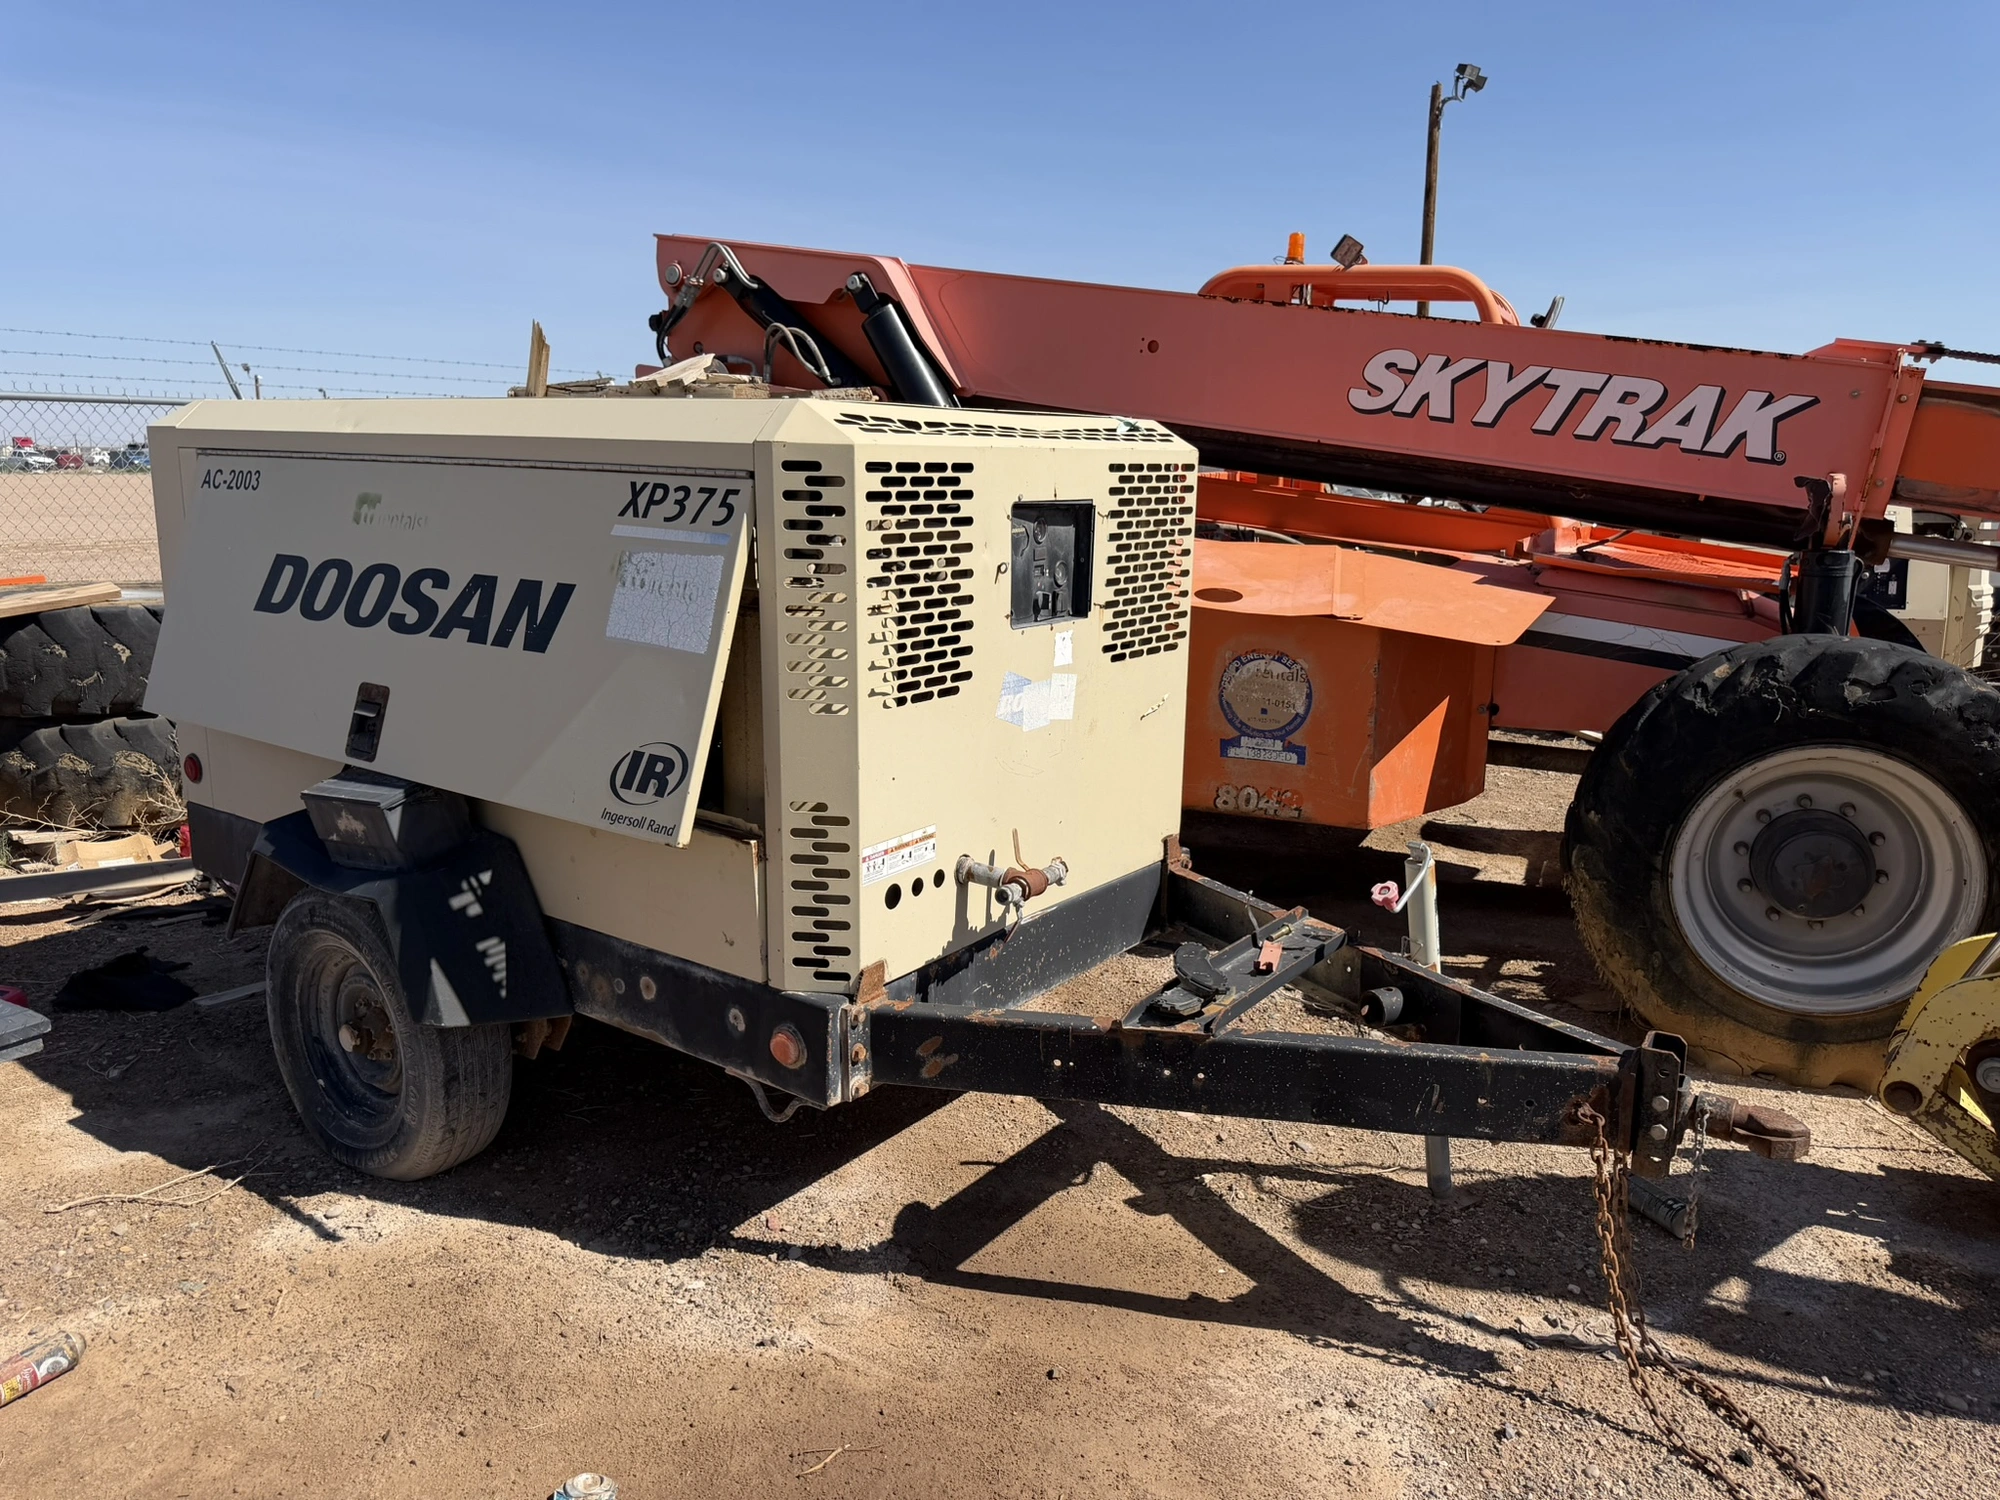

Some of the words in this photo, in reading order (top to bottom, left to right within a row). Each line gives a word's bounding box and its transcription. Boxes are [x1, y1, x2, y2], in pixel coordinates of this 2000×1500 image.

[1347, 347, 1821, 463] SKYTRAK
[200, 468, 261, 491] AC-2003
[617, 480, 741, 527] XP375
[252, 553, 577, 654] DOOSAN
[619, 749, 675, 798] IR
[600, 807, 647, 829] Ingersoll
[646, 818, 677, 837] Rand
